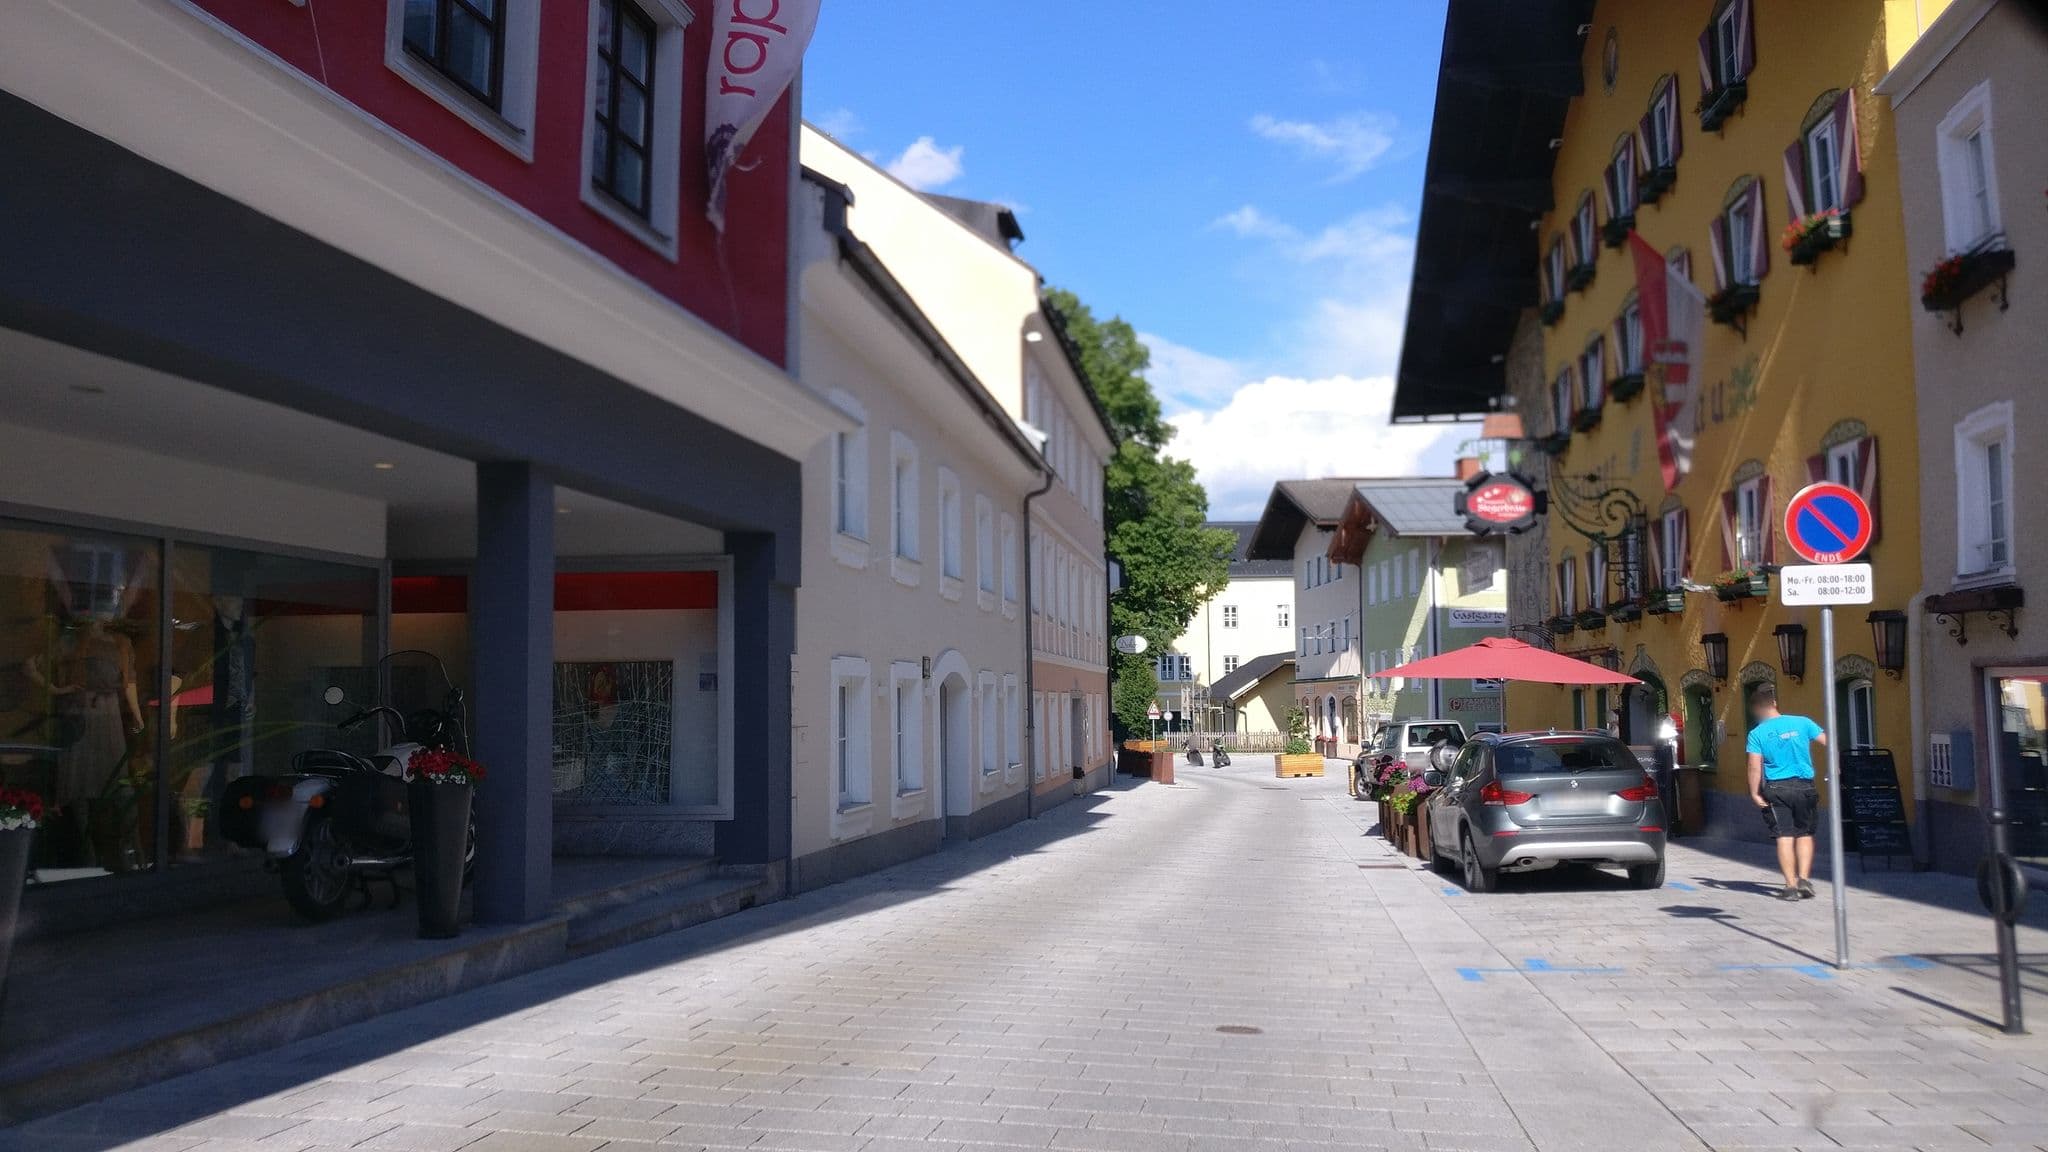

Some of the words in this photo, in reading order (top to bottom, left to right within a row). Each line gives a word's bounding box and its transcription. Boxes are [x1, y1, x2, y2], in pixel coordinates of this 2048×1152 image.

[1814, 552, 1843, 562] ENDE
[1817, 574, 1865, 584] 08:00-18:00
[1787, 588, 1799, 597] Sa.
[1817, 586, 1866, 595] 08:00-12:00
